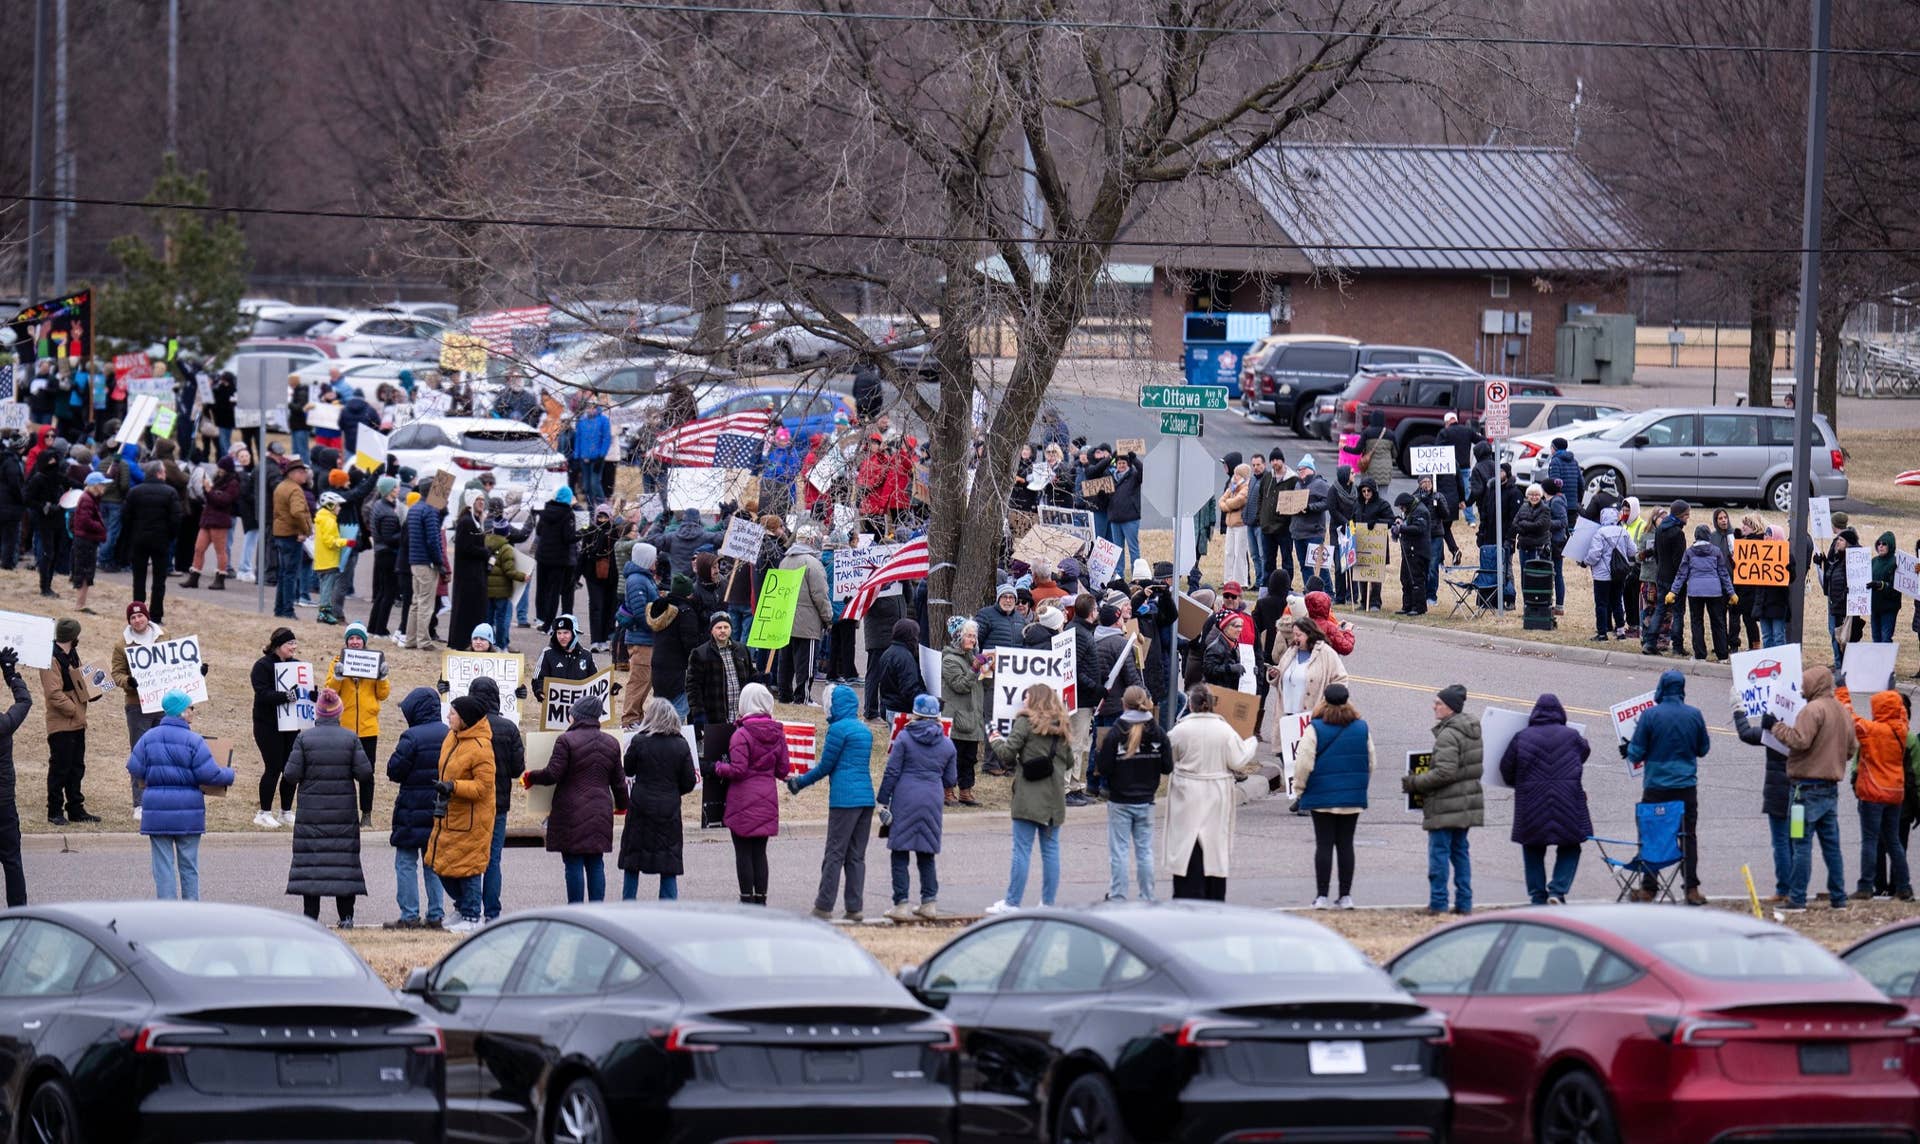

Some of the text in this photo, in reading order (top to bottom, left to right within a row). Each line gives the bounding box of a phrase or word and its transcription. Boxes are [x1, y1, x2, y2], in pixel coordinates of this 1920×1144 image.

[1162, 388, 1222, 406] Ottawa Ave N
[1207, 399, 1220, 408] 650
[1169, 414, 1188, 433] Schaper
[1415, 462, 1451, 474] SCAM
[834, 548, 873, 559] THE ONLY
[1097, 538, 1115, 555] SAVE
[1738, 544, 1782, 562] NAZI
[1738, 562, 1784, 582] CARS
[1898, 554, 1917, 572] Mus
[835, 569, 864, 580] TAKING
[836, 582, 858, 594] USA
[126, 640, 200, 670] IONIQ
[448, 656, 518, 682] PEOPLE
[997, 654, 1063, 677] FUCK
[1063, 670, 1074, 682] TAX
[549, 678, 609, 702] DEFUND
[1616, 700, 1654, 723] DEPOR
[1775, 694, 1796, 713] DONT
